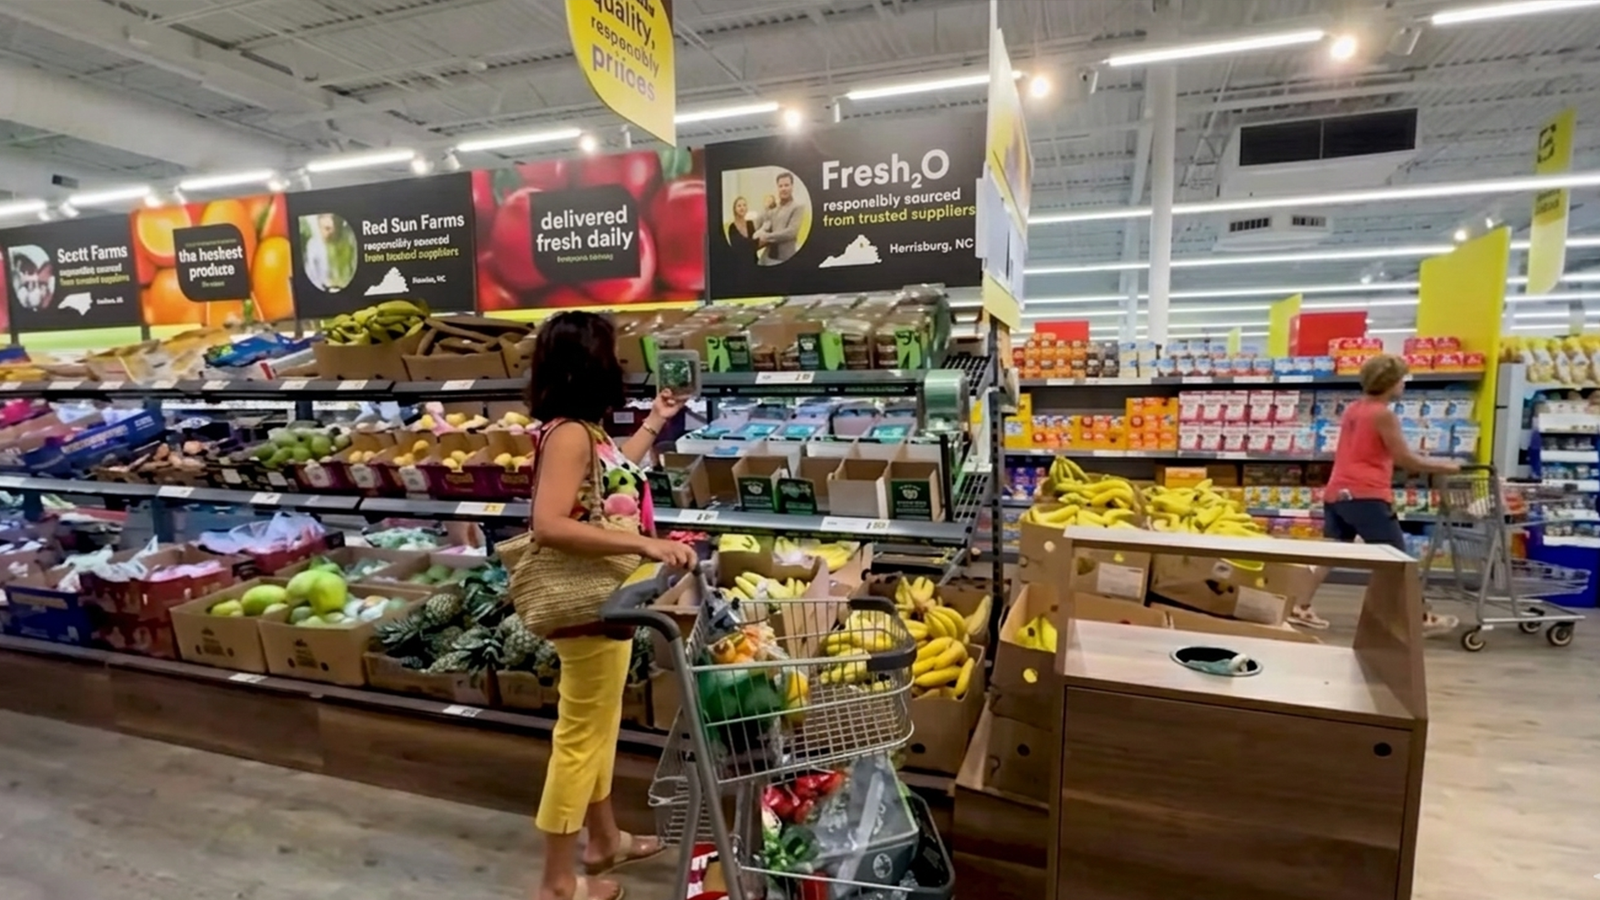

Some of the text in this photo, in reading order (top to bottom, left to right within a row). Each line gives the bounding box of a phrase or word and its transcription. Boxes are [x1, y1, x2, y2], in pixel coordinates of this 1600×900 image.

[362, 214, 465, 235] Red Sun Farms
[541, 204, 628, 230] delivered
[822, 204, 976, 227] from trusted suppliers
[536, 227, 634, 252] fresh daily
[955, 237, 974, 250] NC
[90, 245, 128, 261] Farms
